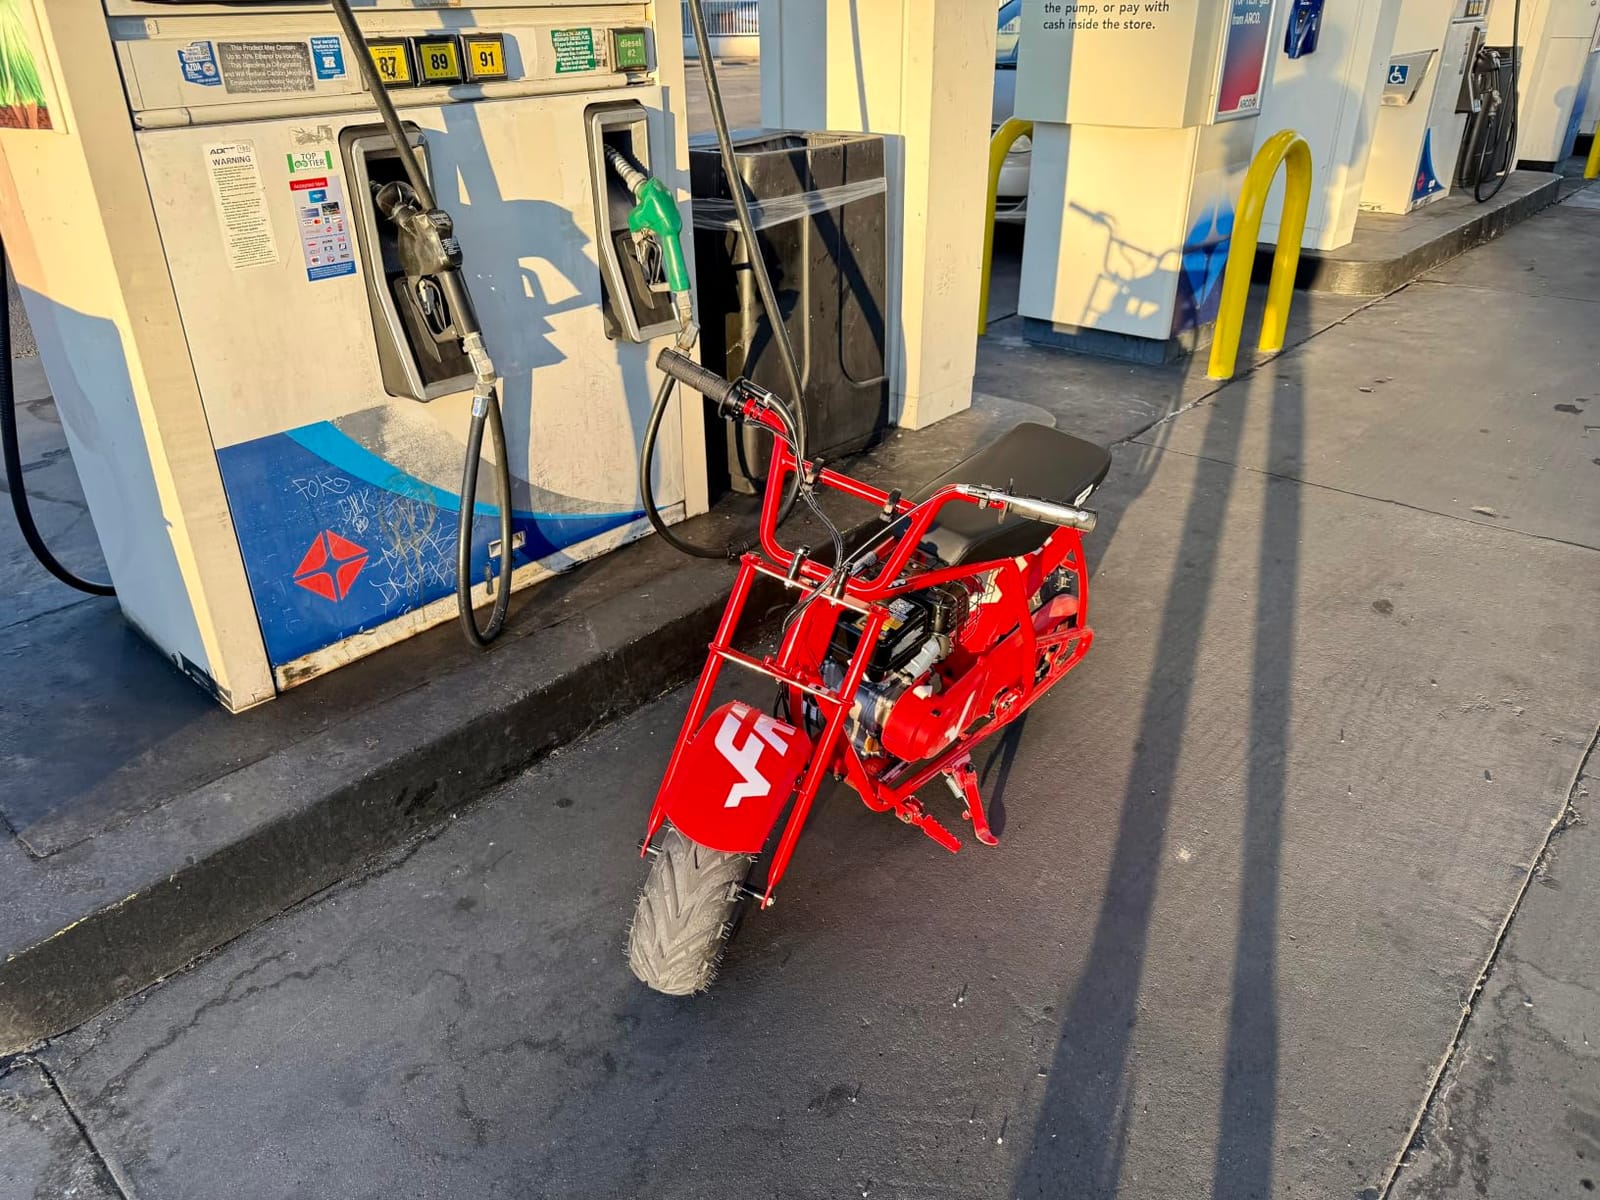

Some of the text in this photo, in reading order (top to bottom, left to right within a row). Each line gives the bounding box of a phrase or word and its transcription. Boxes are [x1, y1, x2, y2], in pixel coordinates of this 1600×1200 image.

[1044, 0, 1170, 16] the pump, or pay with
[1043, 18, 1156, 30] cash inside the store.
[264, 44, 275, 52] May
[620, 37, 642, 48] diesel
[627, 48, 636, 57] #2
[430, 53, 449, 70] 89
[480, 51, 495, 67] 91
[186, 62, 202, 71] AZDA
[379, 56, 397, 74] 87
[212, 155, 251, 166] WARNING
[300, 152, 317, 160] TOP
[309, 159, 326, 167] TIER
